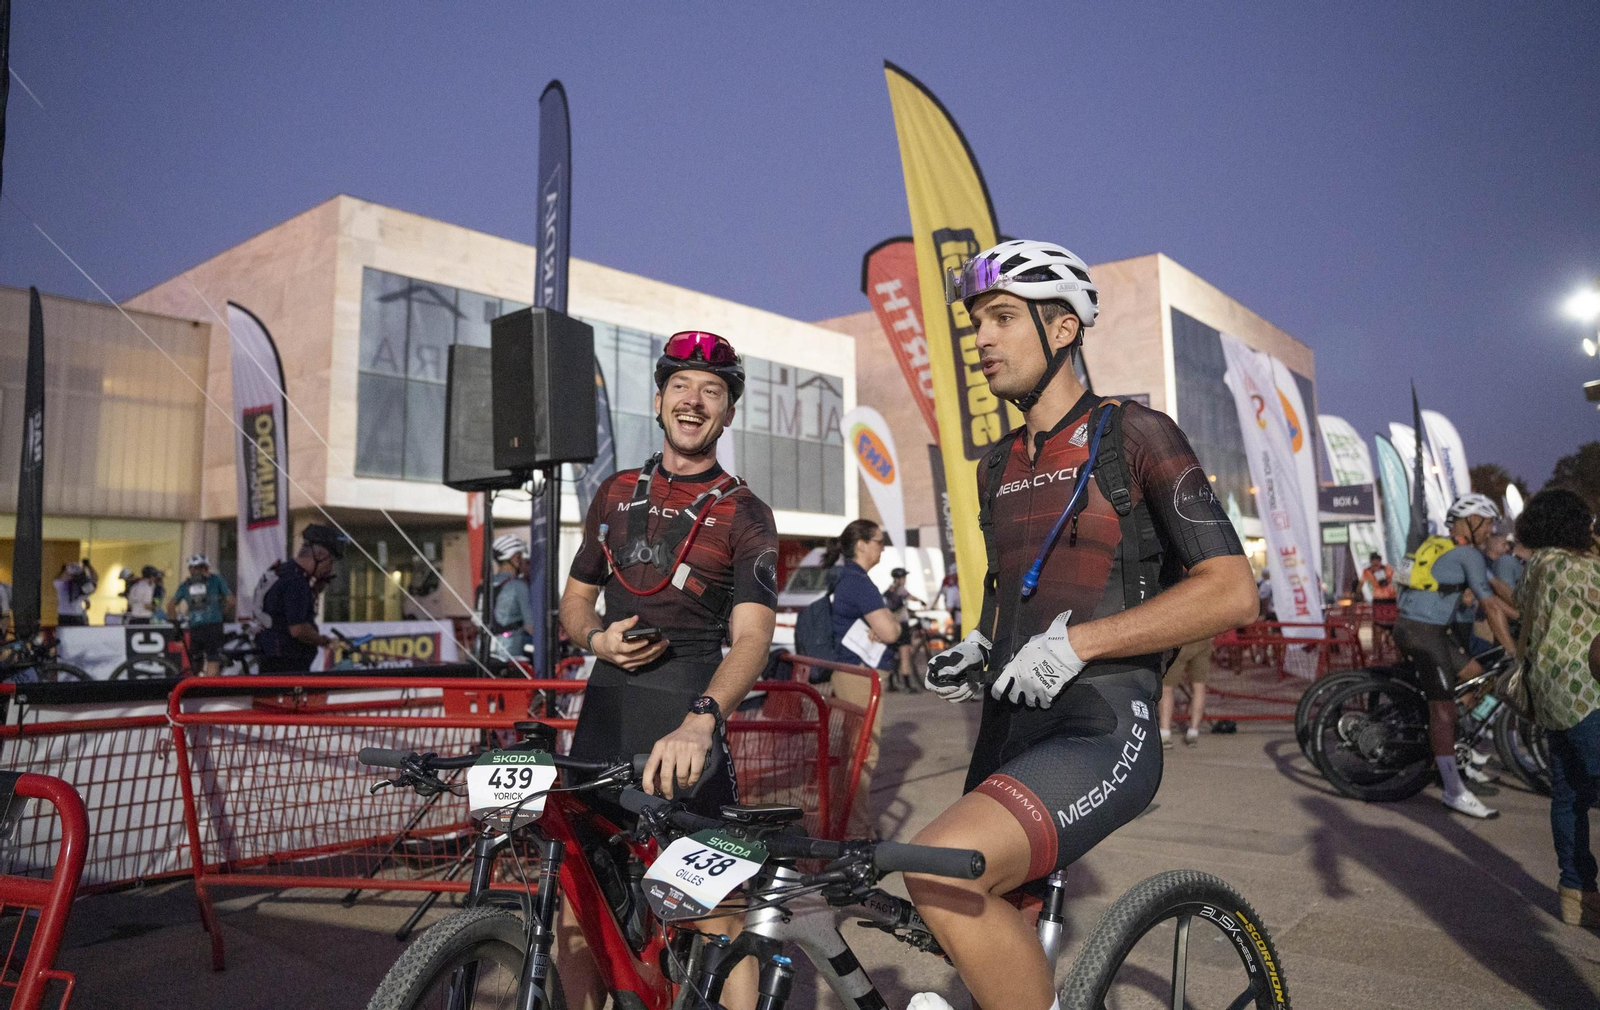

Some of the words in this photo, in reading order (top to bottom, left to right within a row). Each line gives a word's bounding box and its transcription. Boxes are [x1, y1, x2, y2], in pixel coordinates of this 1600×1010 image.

[1332, 496, 1351, 508] BOX
[1352, 496, 1359, 506] 4
[1032, 666, 1053, 690] Percent
[488, 767, 533, 789] 439
[1057, 723, 1147, 828] MEGA-CYCLE
[493, 792, 524, 800] YORICK
[681, 849, 737, 877] 438
[675, 868, 705, 887] GILLES
[870, 900, 894, 915] FACT
[1244, 922, 1285, 1003] SCORPION
